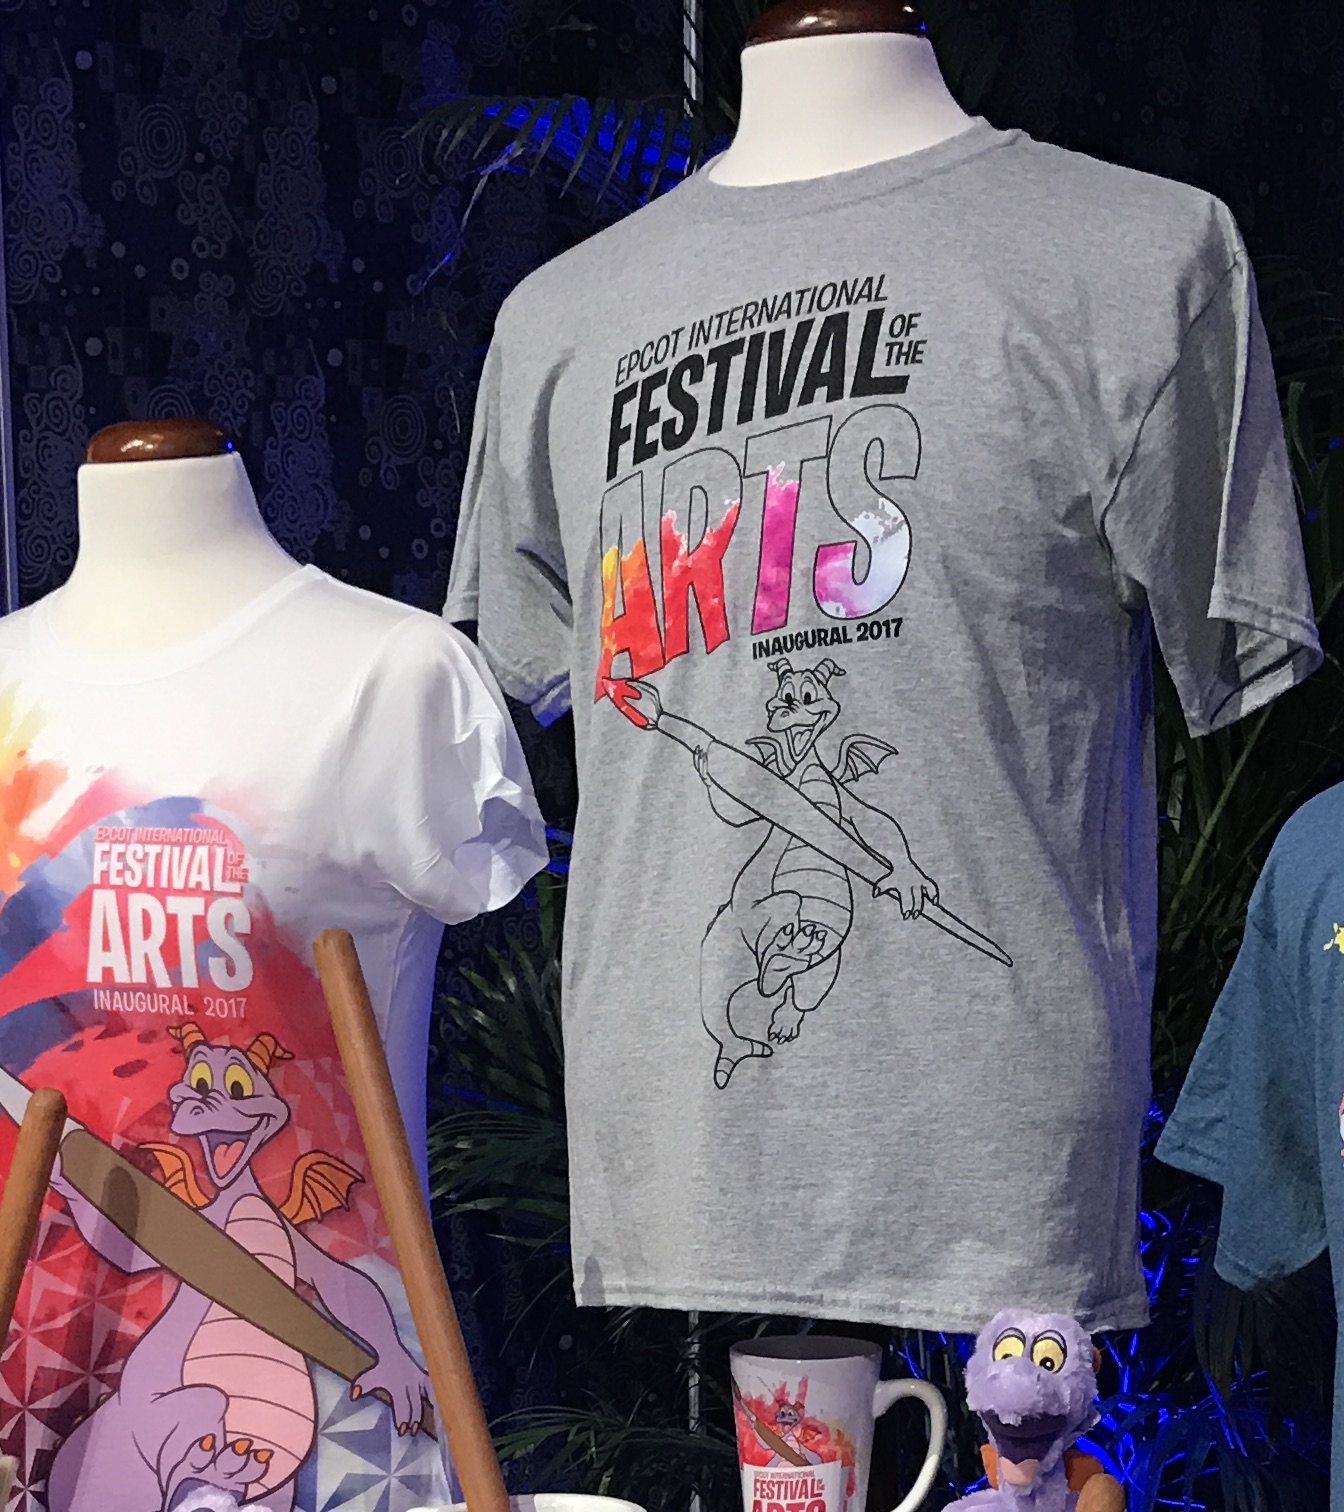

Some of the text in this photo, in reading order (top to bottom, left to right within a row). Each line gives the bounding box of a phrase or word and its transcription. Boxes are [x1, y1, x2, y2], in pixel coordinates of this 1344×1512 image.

[615, 273, 888, 387] EPCOT INTERNATIONAL
[606, 307, 927, 482] FESTIVAL OF THE
[596, 403, 921, 683] ARTS
[752, 617, 904, 660] INAUGURAL 2017
[95, 826, 227, 845] EPCOT INTERNATIONAL
[92, 842, 248, 894] FESTIVAL OF THE
[86, 888, 254, 992] ARTS
[93, 989, 247, 1019] INAUGURAL 2017
[754, 1479, 822, 1500] FESTIVAL
